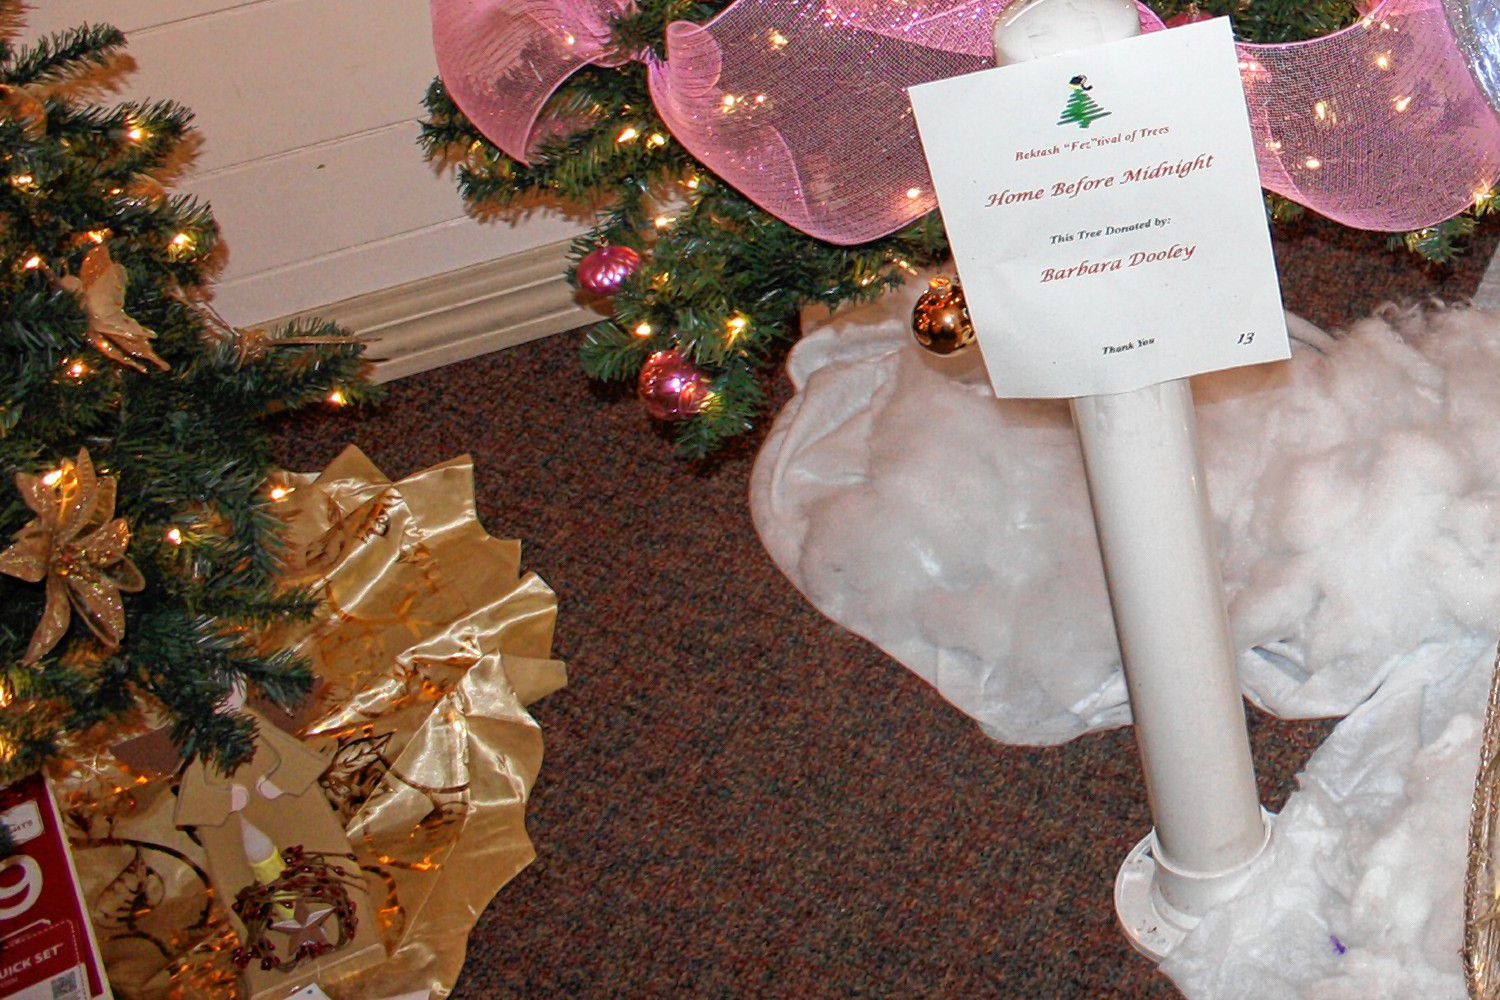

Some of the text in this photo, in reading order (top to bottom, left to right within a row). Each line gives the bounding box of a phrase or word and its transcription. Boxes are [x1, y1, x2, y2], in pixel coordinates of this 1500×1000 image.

[1014, 145, 1060, 162] Bektash
[1124, 130, 1138, 144] of
[1140, 124, 1169, 139] Trees
[984, 153, 1214, 208] Home Before Midnight
[1050, 216, 1171, 245] This Tree Donated by:
[1040, 243, 1196, 283] Barbara Dooley
[1102, 336, 1156, 355] Thank You
[1237, 332, 1255, 345] 13
[0, 942, 64, 978] UICK SET
